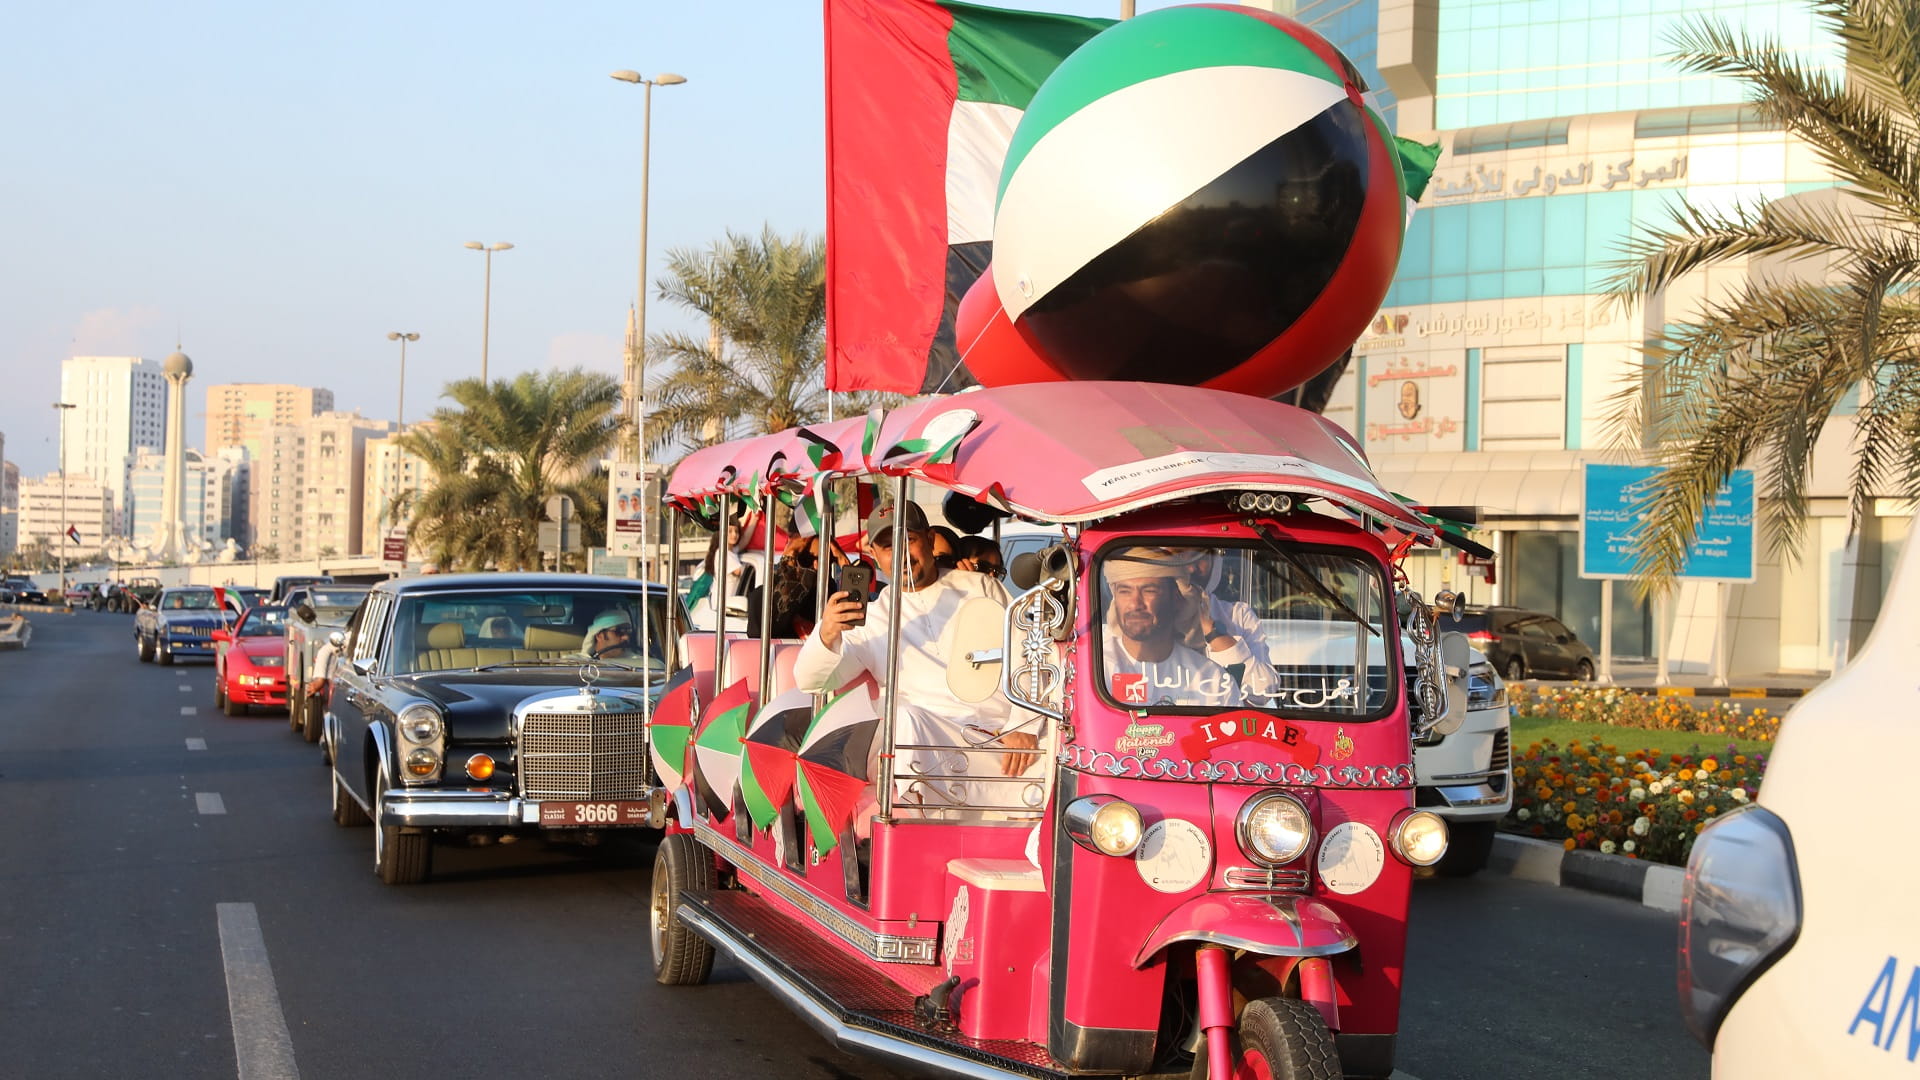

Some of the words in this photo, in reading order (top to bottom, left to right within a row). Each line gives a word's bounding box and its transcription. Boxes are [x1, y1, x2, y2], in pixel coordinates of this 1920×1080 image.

[1431, 164, 1505, 198] للأشعة
[1601, 155, 1688, 190] المركز
[1101, 474, 1127, 487] YEAR
[1130, 470, 1143, 478] OF
[1145, 458, 1205, 474] TOLERANCE
[1133, 661, 1190, 704] العالم
[1117, 733, 1173, 751] National
[1127, 725, 1163, 738] Happy
[1200, 723, 1218, 743] I
[1241, 718, 1300, 747] UAE
[1138, 747, 1157, 757] Day
[575, 803, 618, 823] 3666
